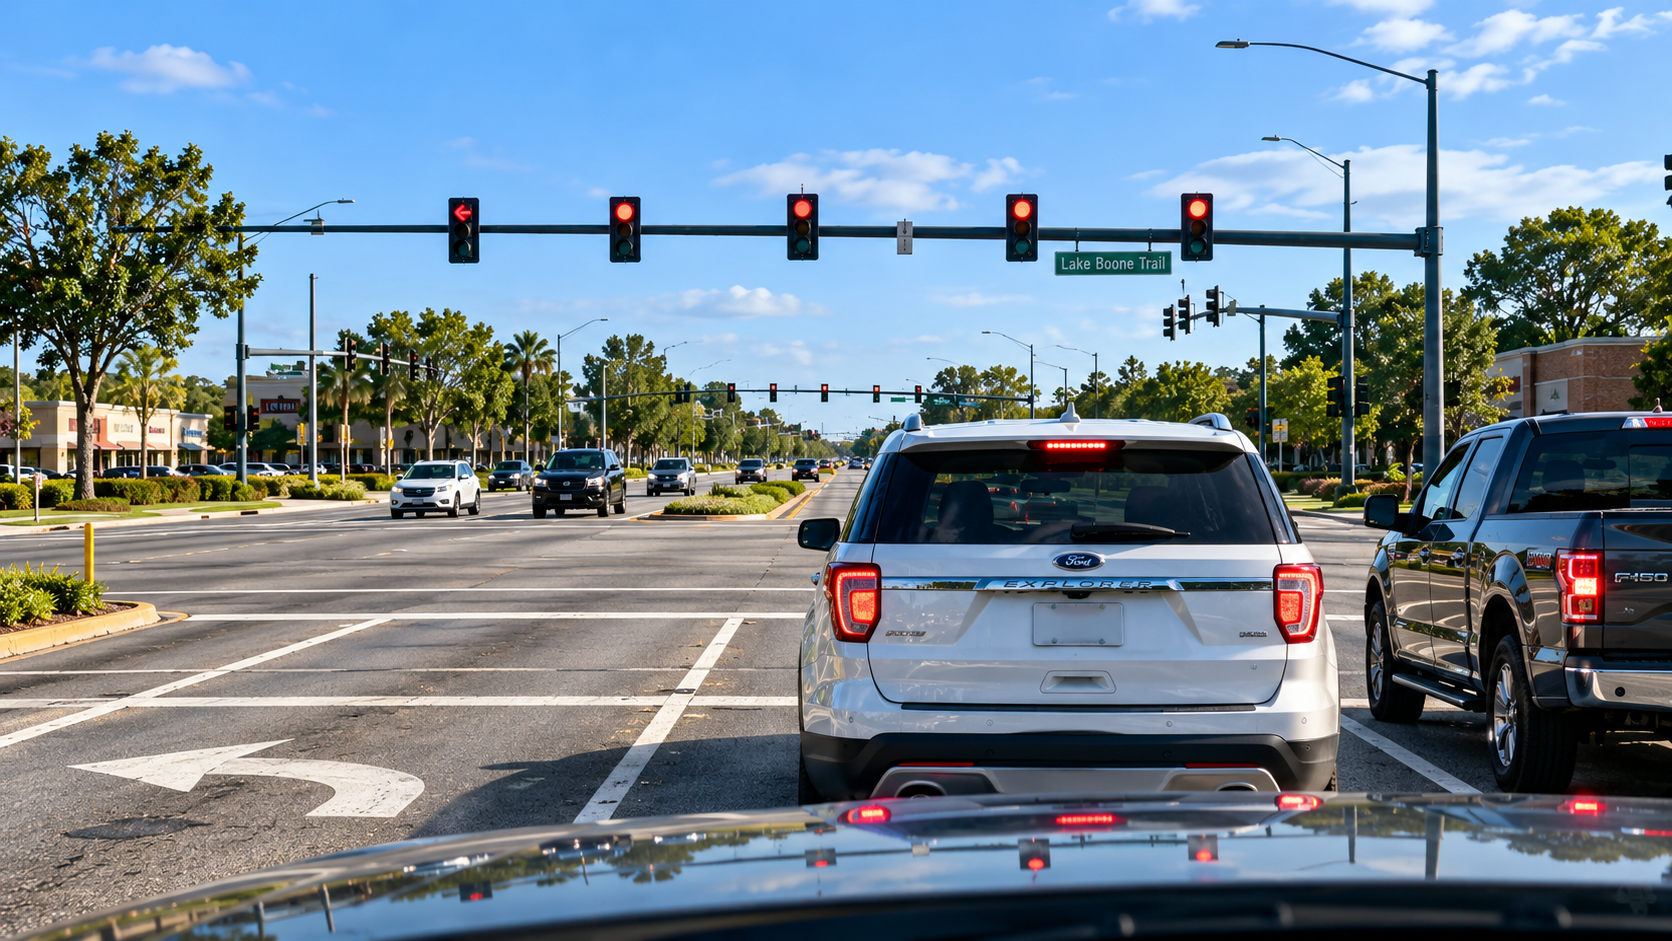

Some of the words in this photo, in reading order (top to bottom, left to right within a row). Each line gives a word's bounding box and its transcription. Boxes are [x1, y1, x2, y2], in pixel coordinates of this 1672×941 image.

[1061, 257, 1091, 270] Lake
[1096, 257, 1134, 270] Boone
[1139, 256, 1165, 270] Trail
[1065, 555, 1092, 567] Ford
[1003, 580, 1153, 588] EXPLORER
